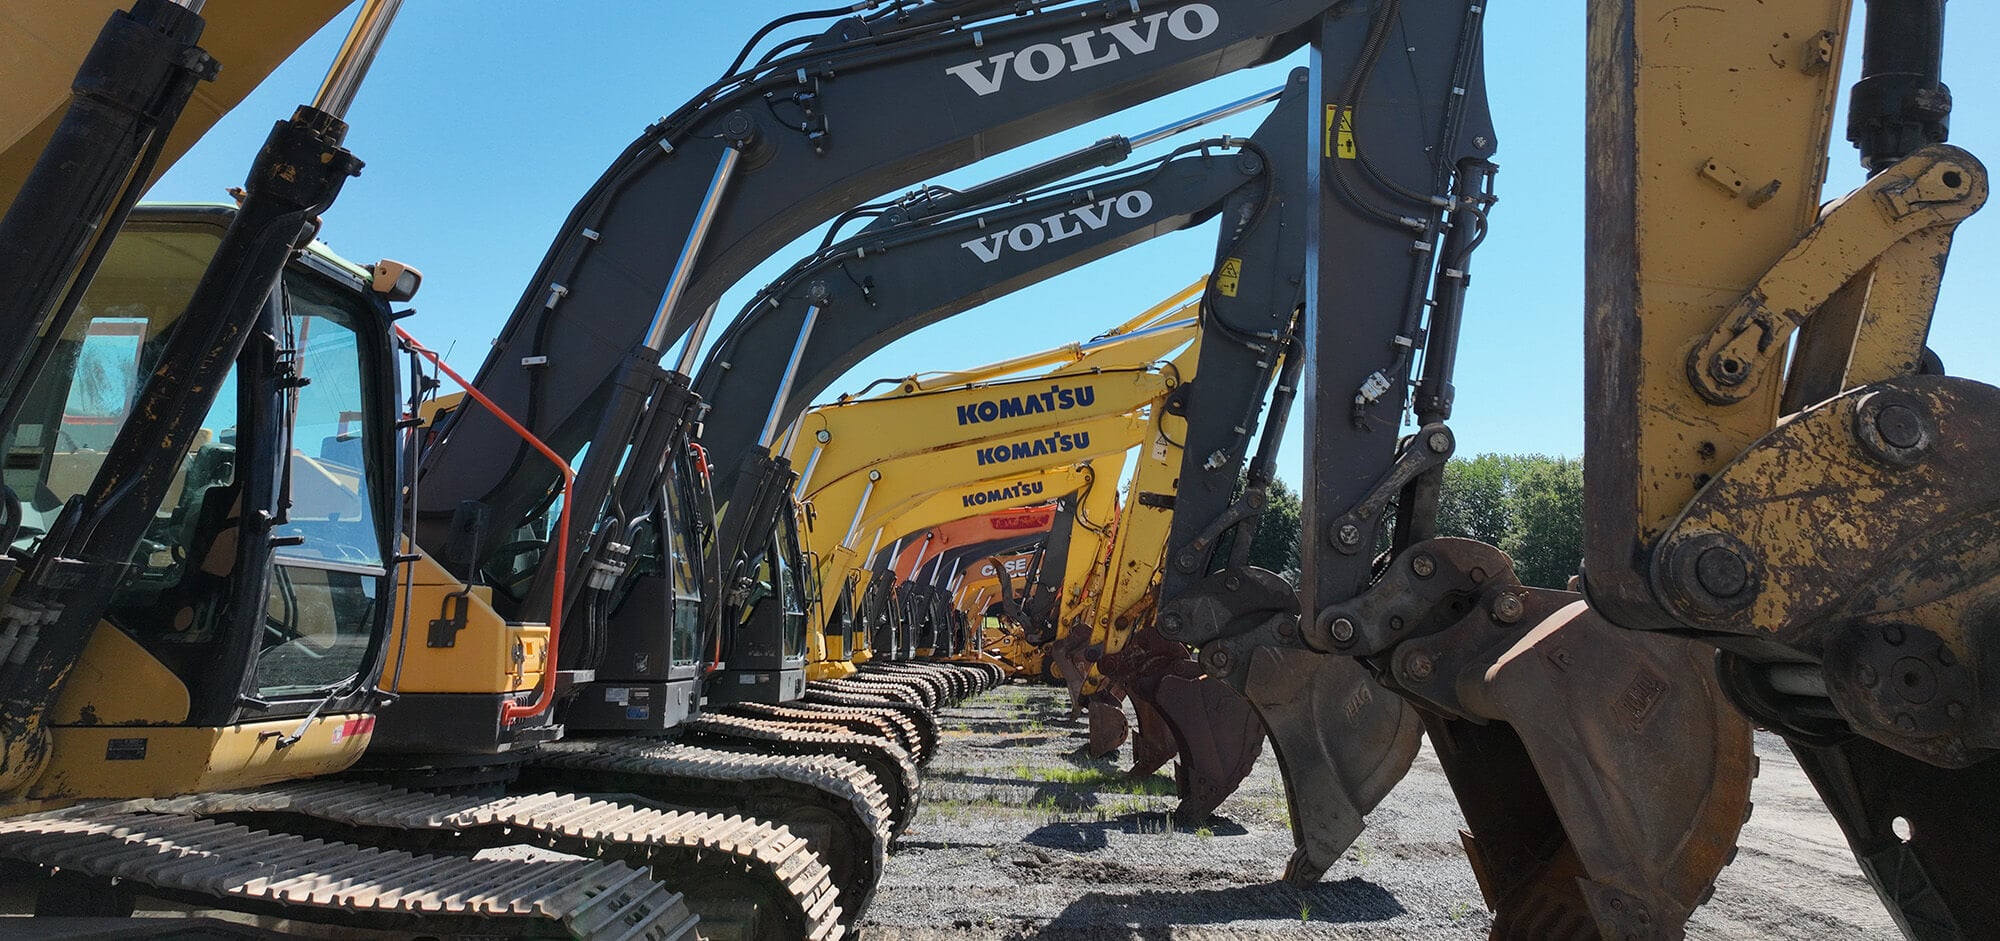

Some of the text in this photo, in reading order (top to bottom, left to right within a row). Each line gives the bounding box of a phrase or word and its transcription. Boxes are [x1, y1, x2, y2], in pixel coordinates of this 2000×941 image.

[946, 4, 1220, 96] VOLVO
[961, 190, 1153, 263] VOLVO
[957, 385, 1095, 426] KOMATSU
[977, 431, 1090, 466] KOMATSU
[962, 481, 1043, 507] KOMATSU
